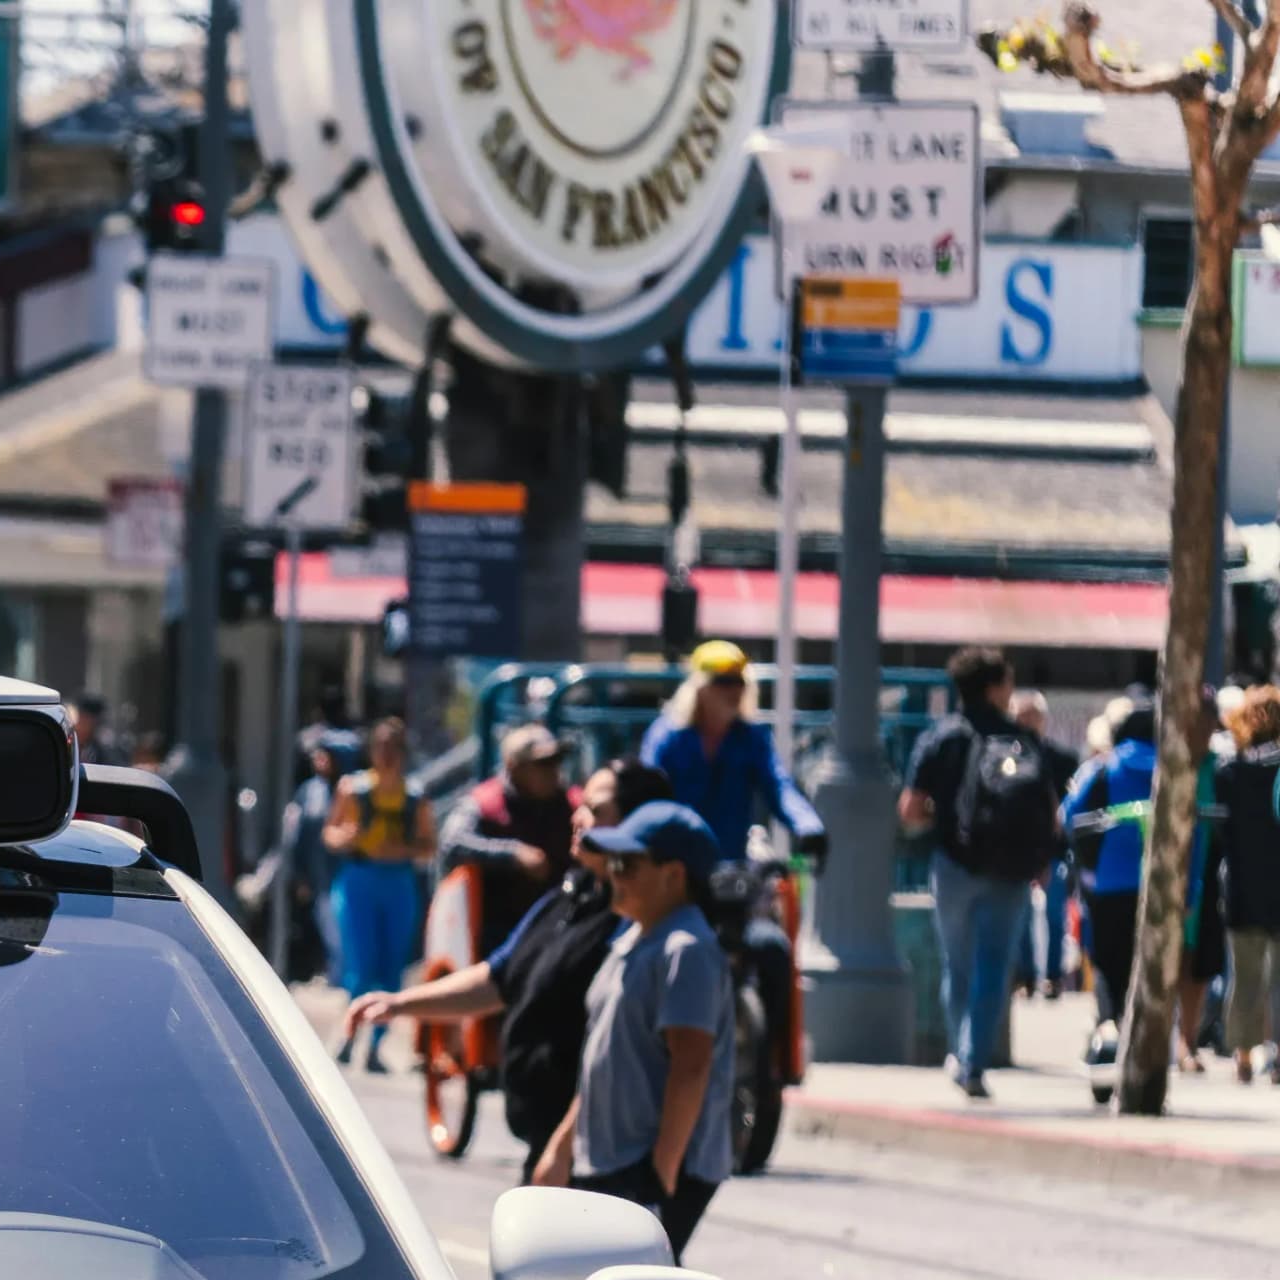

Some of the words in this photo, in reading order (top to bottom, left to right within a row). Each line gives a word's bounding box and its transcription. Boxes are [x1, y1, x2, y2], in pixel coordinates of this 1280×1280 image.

[480, 107, 555, 222] SAN
[561, 36, 742, 248] FRANCISCO
[892, 131, 965, 162] LANE
[804, 243, 866, 270] URN
[261, 376, 340, 402] STOP
